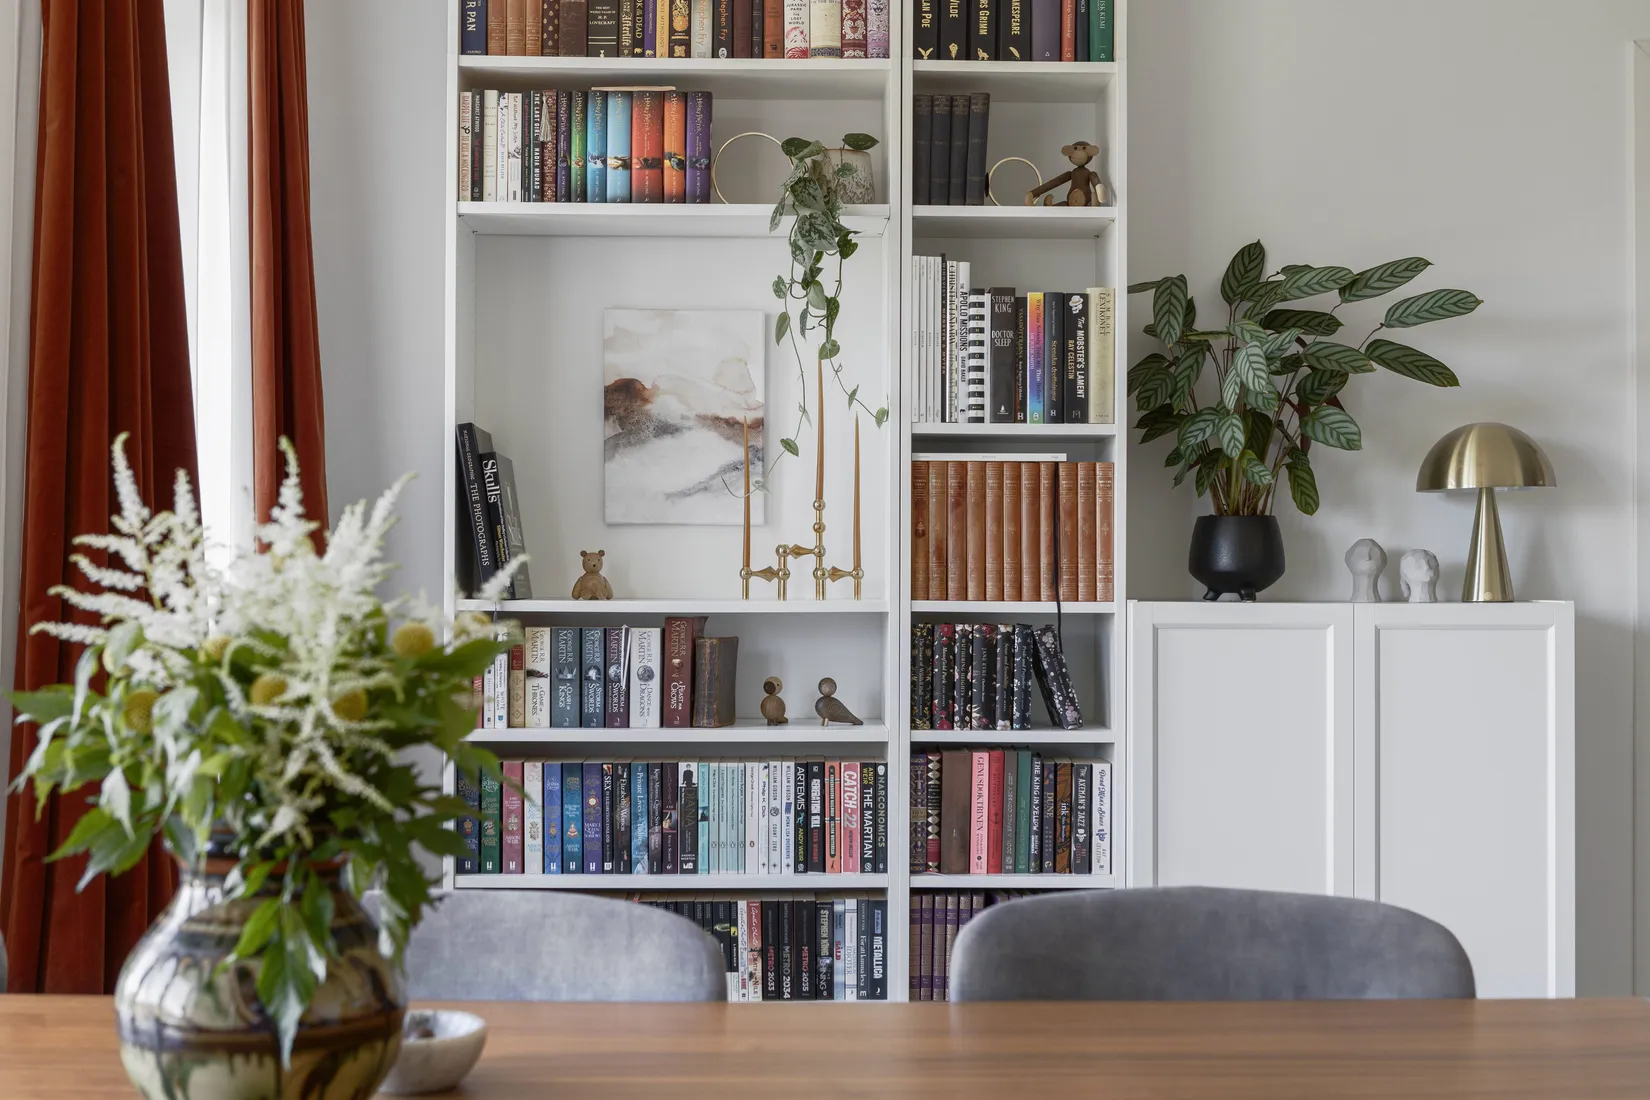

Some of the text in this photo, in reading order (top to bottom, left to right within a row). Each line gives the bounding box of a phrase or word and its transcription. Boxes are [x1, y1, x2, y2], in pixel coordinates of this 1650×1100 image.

[467, 11, 476, 31] PAN
[719, 29, 727, 40] Fry
[922, 14, 932, 28] POE
[980, 11, 989, 34] GRIMM
[995, 304, 1012, 313] KING
[992, 330, 1014, 338] DOCTOR
[1076, 330, 1085, 368] MOBSTER'S
[482, 459, 500, 503] Skulls
[470, 483, 490, 566] THE PHOTOGRAPHS
[611, 630, 619, 662] MARTIN
[671, 621, 680, 657] MARTIN
[684, 787, 695, 827] DIANA
[811, 779, 820, 828] GENERATION KILL
[844, 771, 857, 828] CATCH-22
[976, 756, 984, 831] GENUSDOKTRINEN
[1098, 770, 1106, 826] Dead Blues
[864, 788, 872, 858] THE MARTIAN
[820, 910, 829, 956] STEPHEN KING
[874, 936, 882, 979] METALLICA
